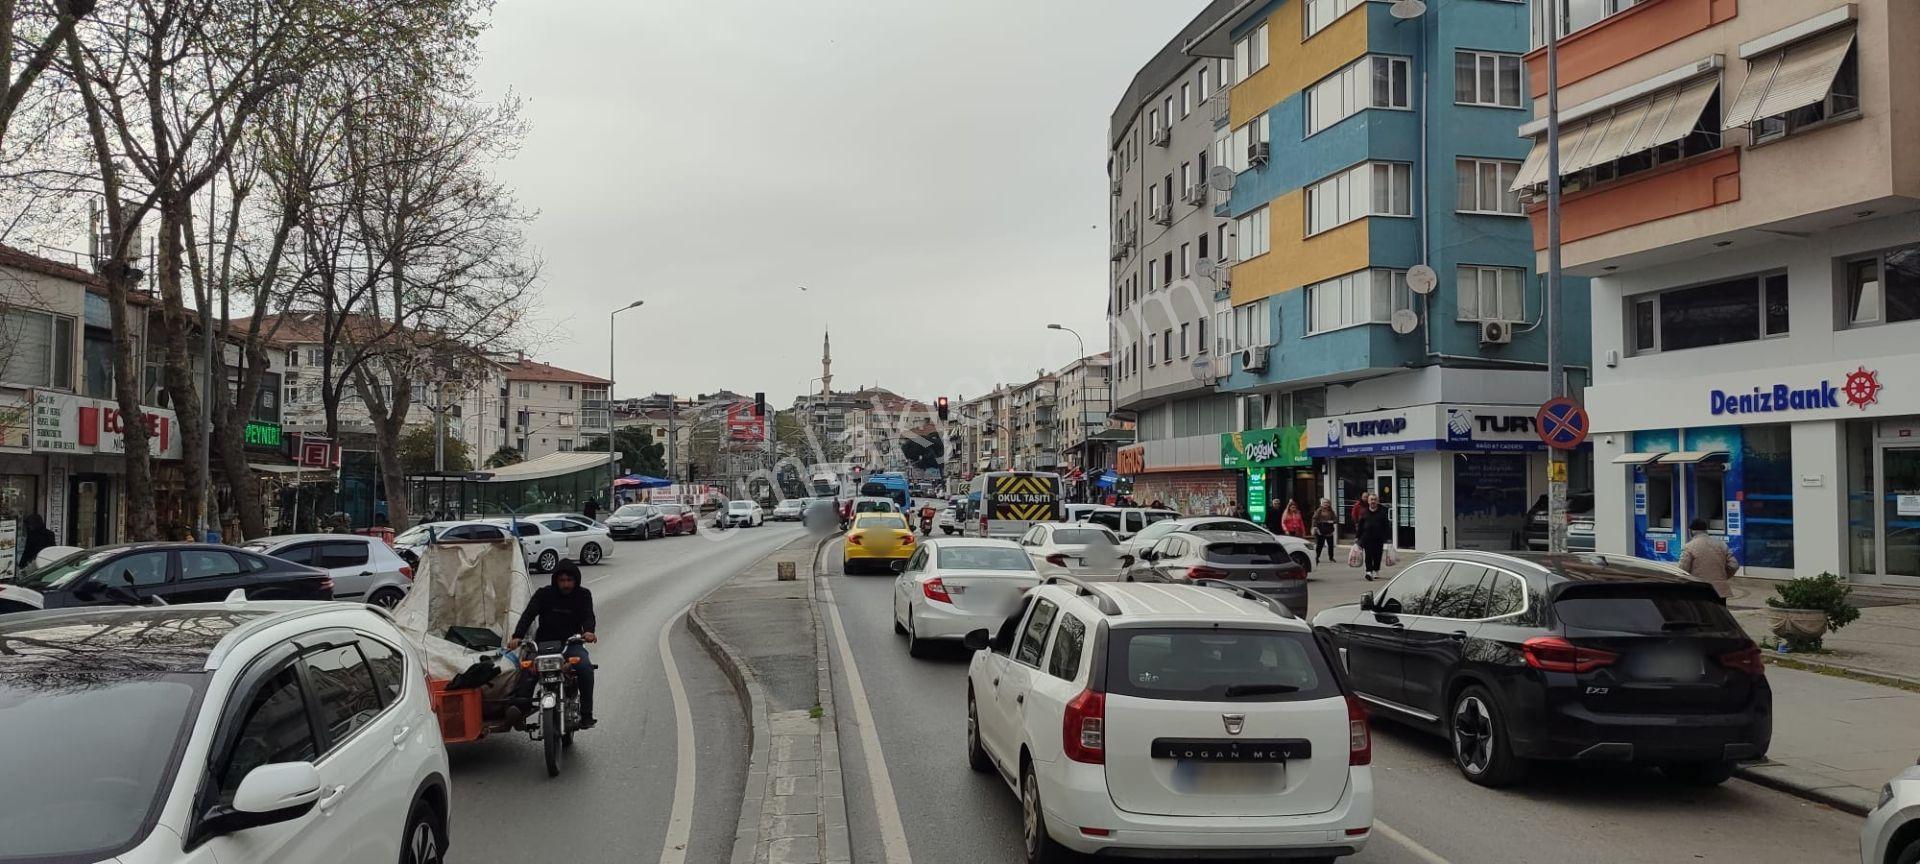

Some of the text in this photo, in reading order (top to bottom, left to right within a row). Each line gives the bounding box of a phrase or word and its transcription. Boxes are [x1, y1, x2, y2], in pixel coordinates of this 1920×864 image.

[1710, 380, 1840, 415] DenizBank
[1344, 417, 1407, 437] TURYAP
[1475, 415, 1538, 432] TURY
[997, 493, 1051, 504] OKUL TAŞITI
[1169, 750, 1292, 758] LOGAN MCV
